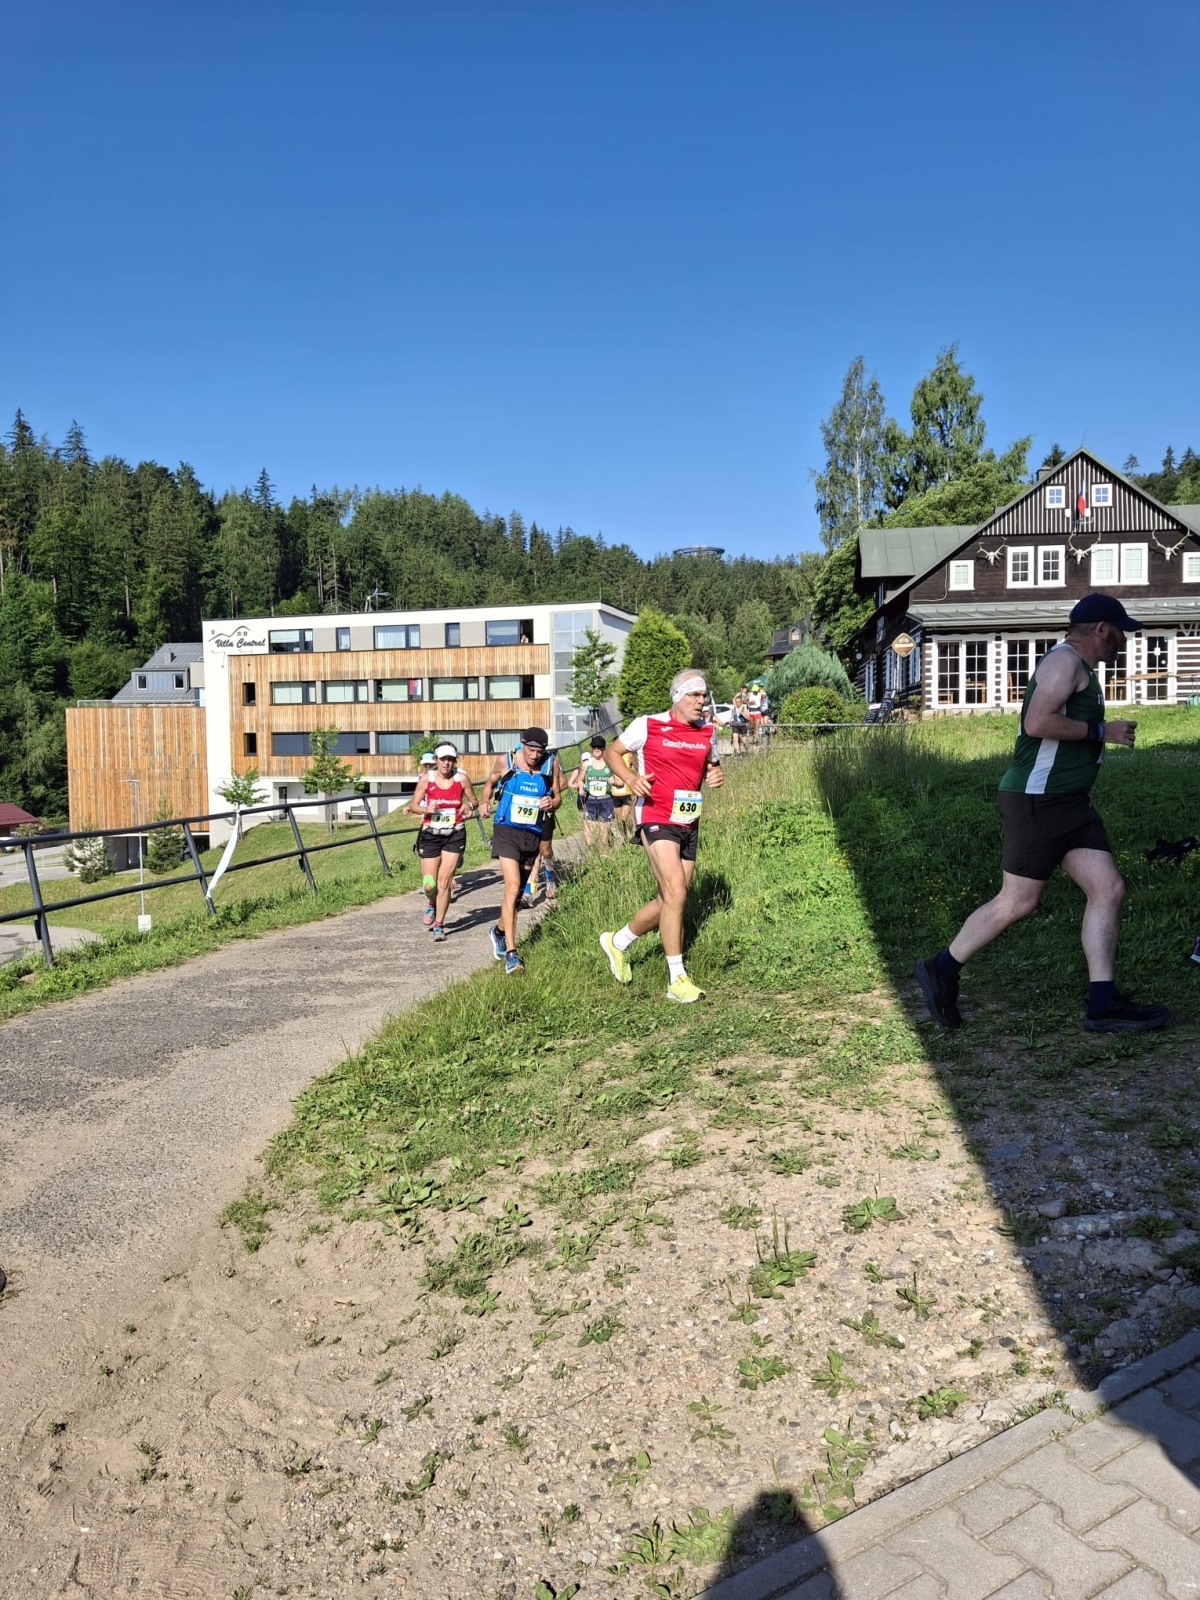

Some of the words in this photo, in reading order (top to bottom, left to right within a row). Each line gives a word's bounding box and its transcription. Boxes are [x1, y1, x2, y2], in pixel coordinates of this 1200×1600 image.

[214, 639, 234, 648] Villa
[236, 637, 266, 649] Central
[520, 785, 539, 793] ITALIA
[517, 806, 533, 816] 795
[679, 802, 697, 813] 630
